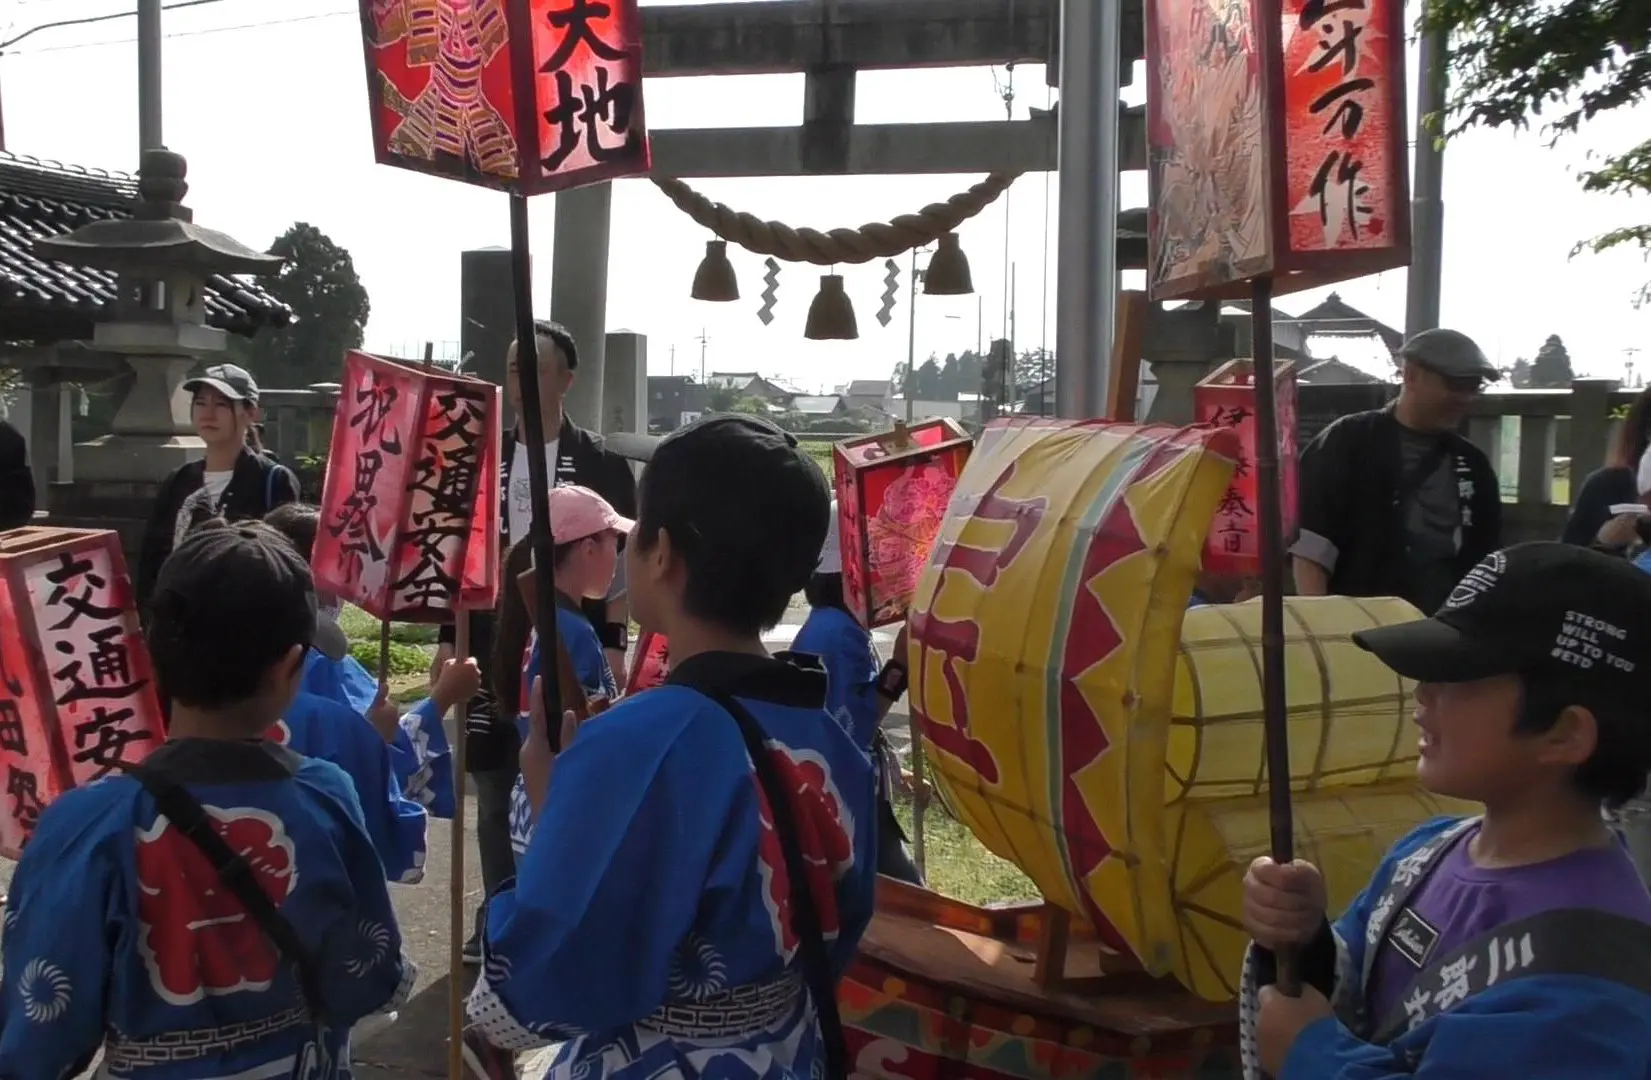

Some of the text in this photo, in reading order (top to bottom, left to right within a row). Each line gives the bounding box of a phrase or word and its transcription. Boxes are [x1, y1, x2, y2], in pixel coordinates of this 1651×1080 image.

[390, 384, 487, 609] 交通安全
[1562, 622, 1599, 643] WILL
[1564, 610, 1627, 640] STRONG
[1582, 641, 1602, 659] TO
